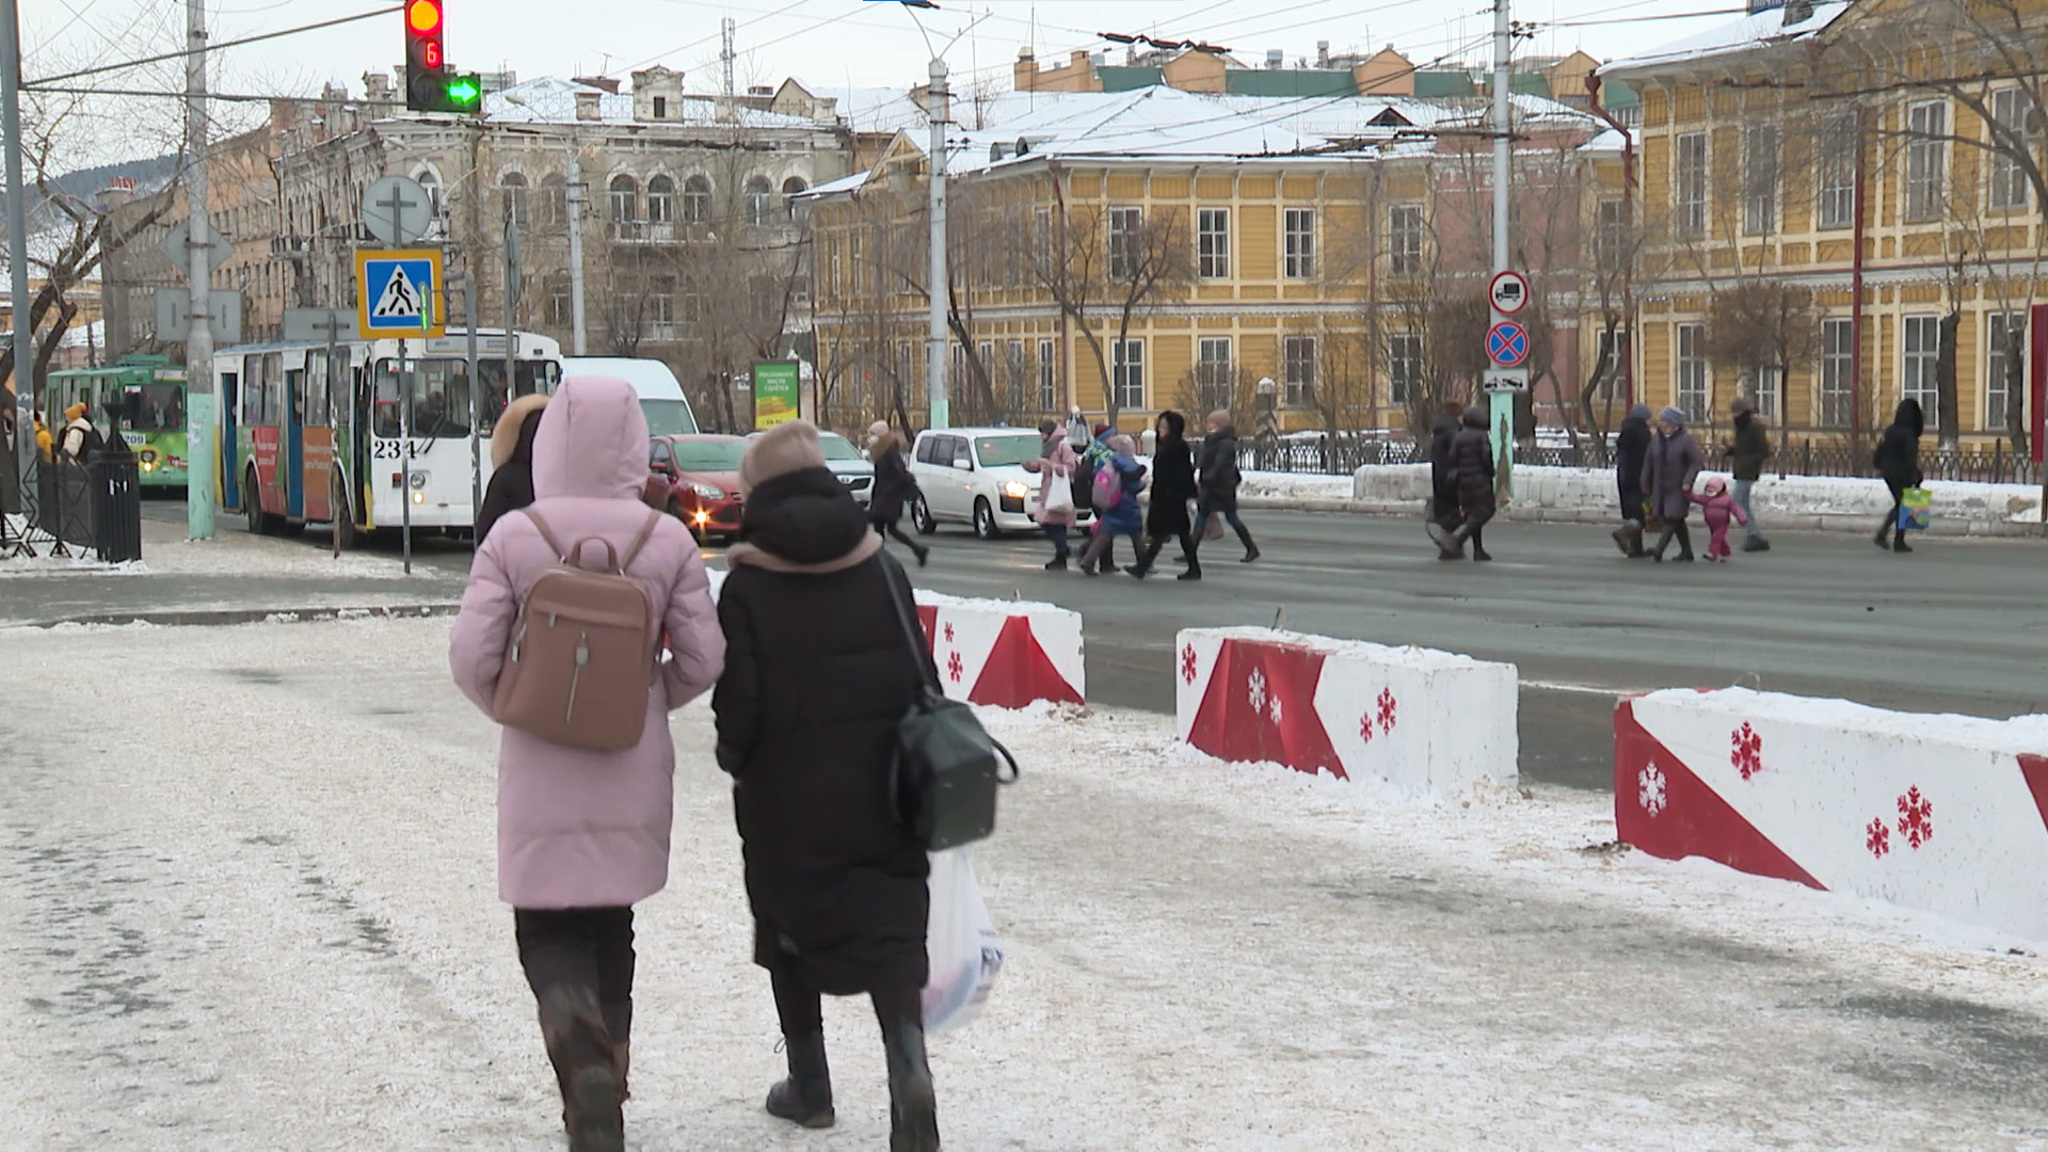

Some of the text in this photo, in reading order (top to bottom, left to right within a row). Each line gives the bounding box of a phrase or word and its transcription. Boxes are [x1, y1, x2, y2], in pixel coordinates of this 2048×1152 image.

[426, 41, 440, 66] 6
[124, 435, 144, 445] 209
[374, 440, 417, 459] 234
